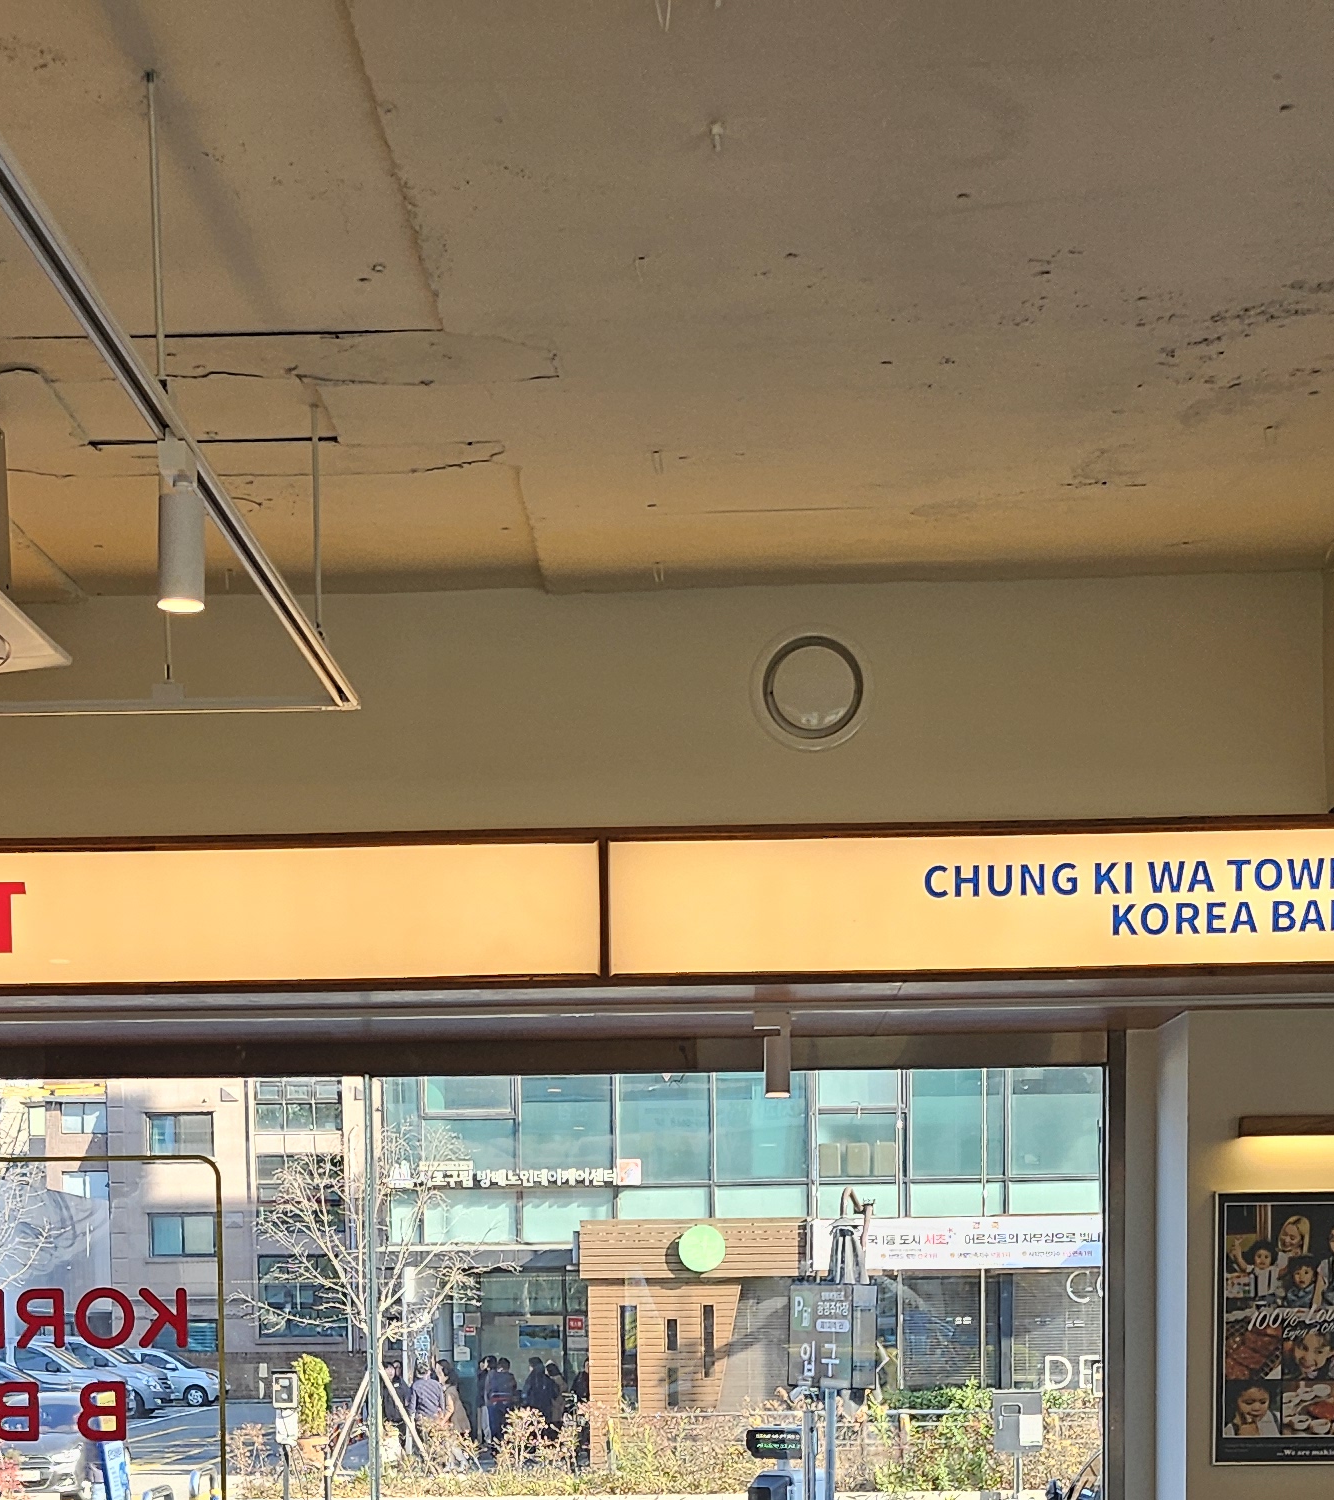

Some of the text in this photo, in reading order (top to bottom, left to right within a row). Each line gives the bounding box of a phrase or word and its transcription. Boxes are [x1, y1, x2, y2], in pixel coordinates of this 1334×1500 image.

[924, 861, 1079, 898] CHUNG
[1094, 861, 1133, 895] KI
[1147, 859, 1215, 894] WA
[1112, 901, 1258, 936] KOREA
[899, 1234, 922, 1246] 도시
[1248, 1307, 1298, 1331] 100%
